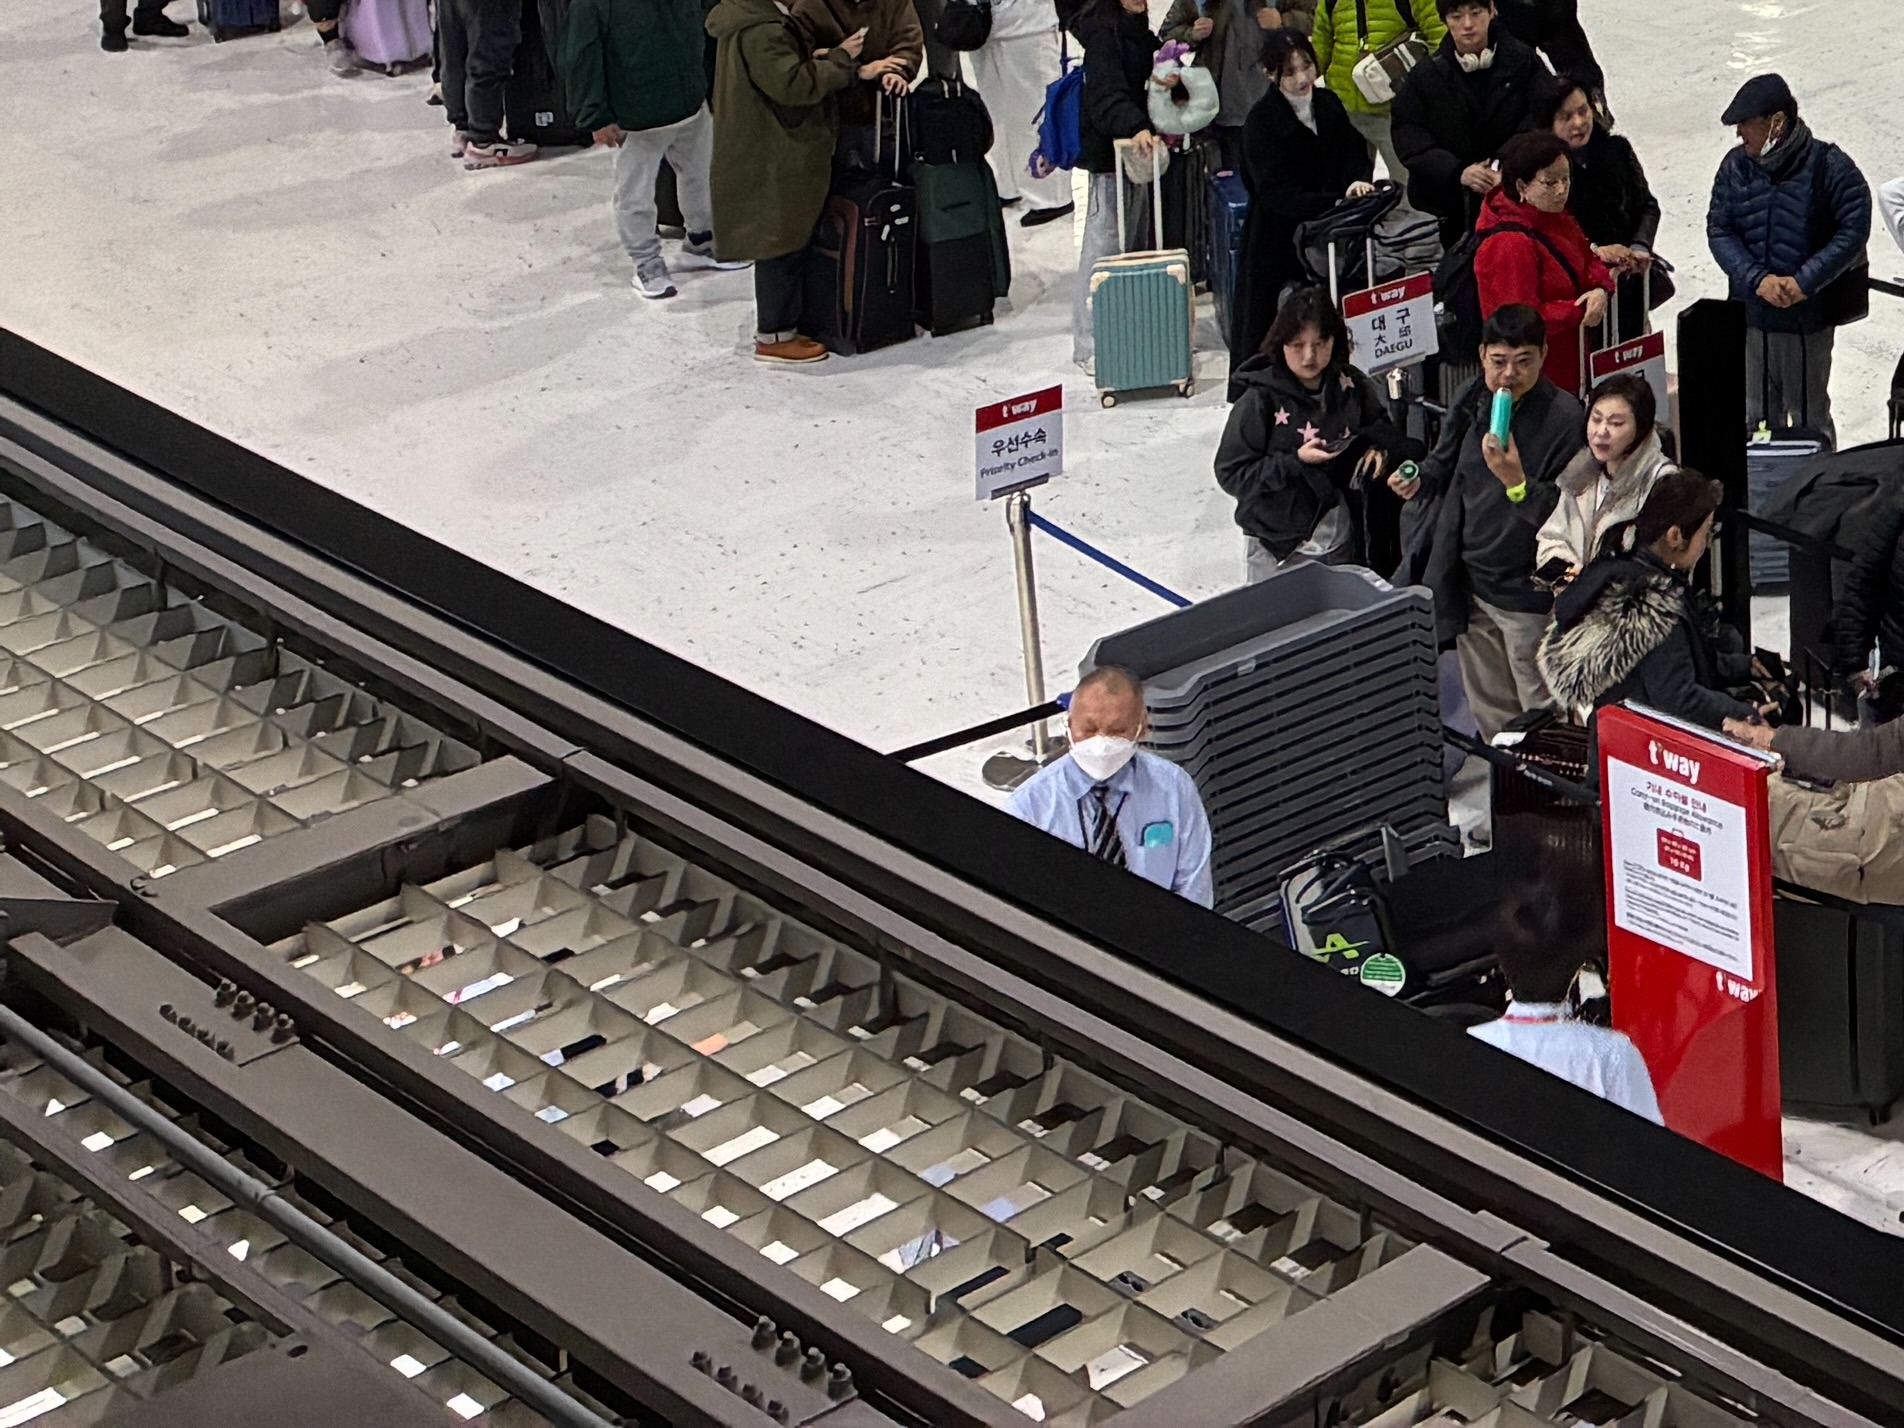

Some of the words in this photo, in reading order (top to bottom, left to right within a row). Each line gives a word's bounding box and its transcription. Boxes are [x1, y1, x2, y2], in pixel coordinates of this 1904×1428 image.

[1374, 338, 1413, 359] DAEGU
[991, 427, 1047, 457] 우선수속
[980, 462, 1017, 479] Priority
